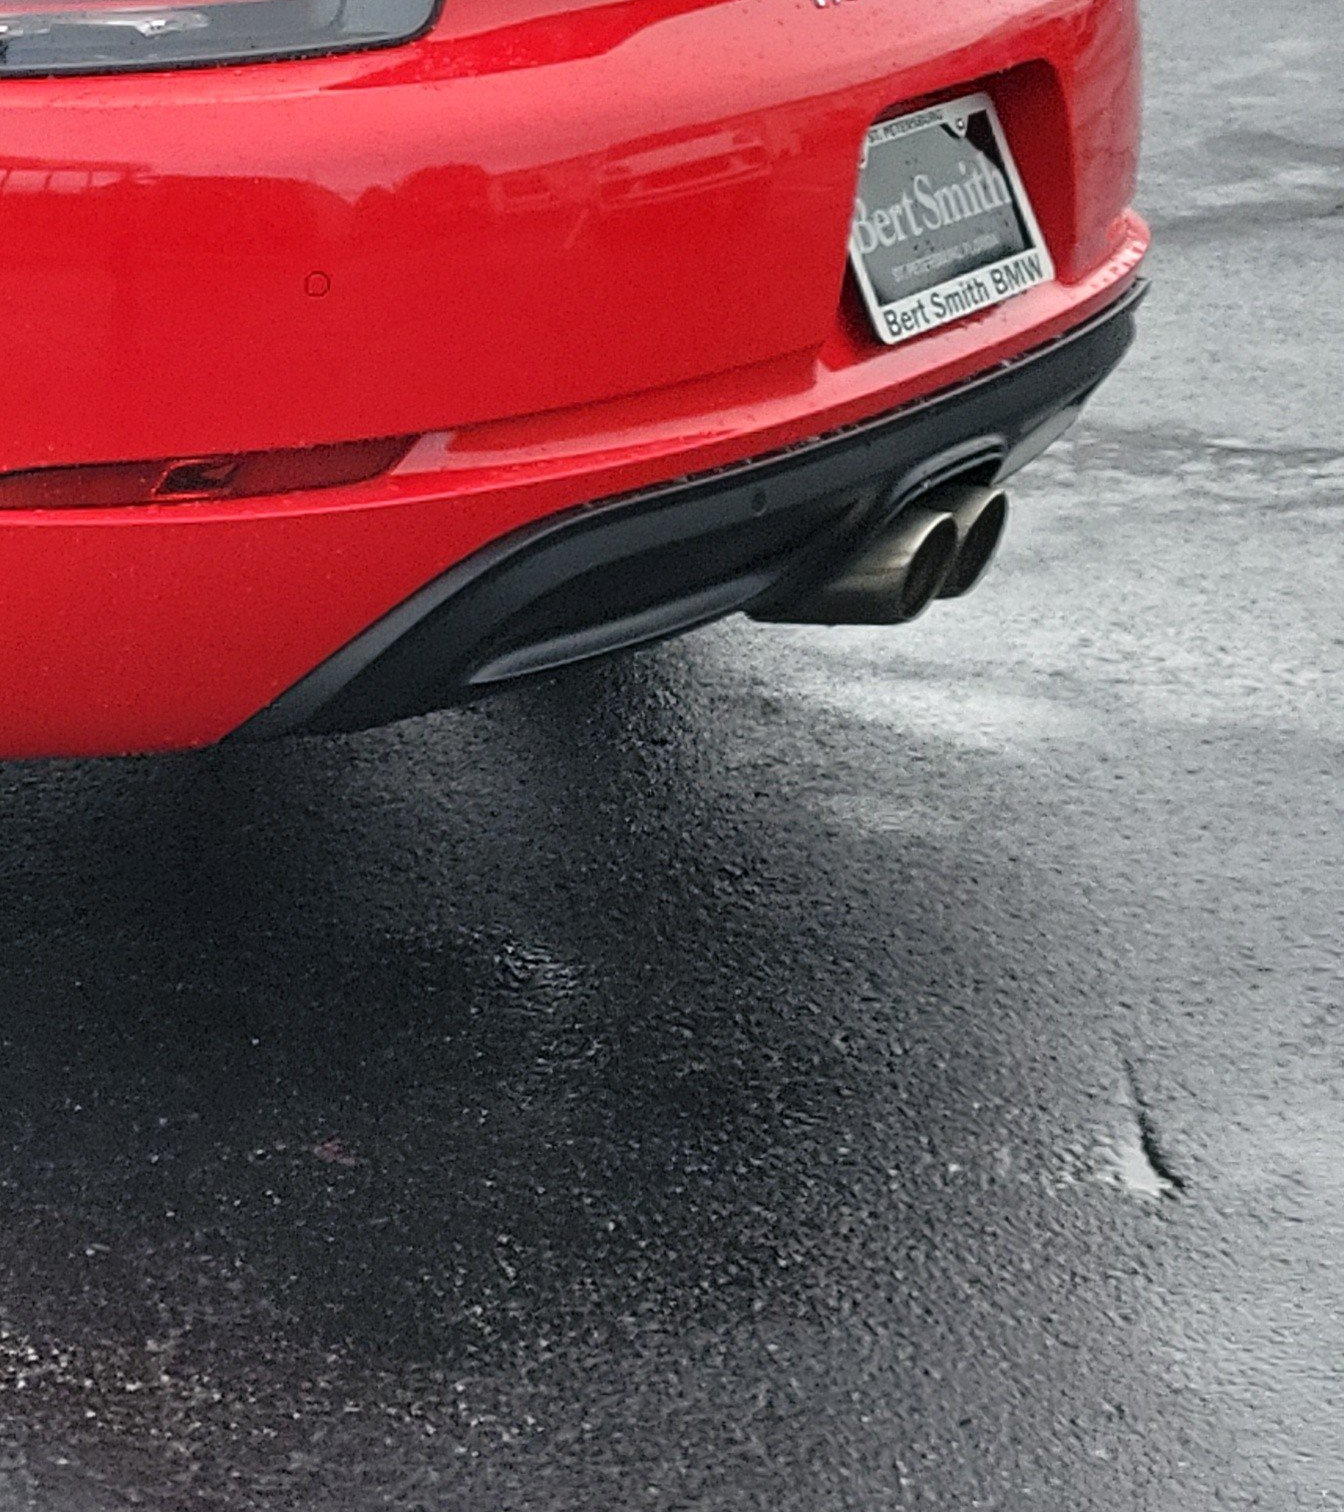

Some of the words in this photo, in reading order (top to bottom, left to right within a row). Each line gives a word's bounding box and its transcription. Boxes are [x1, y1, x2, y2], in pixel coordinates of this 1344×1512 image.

[853, 191, 924, 255] Bert
[913, 151, 1012, 230] Smith
[882, 299, 931, 337] Bert
[930, 278, 991, 319] Smith
[989, 254, 1044, 296] BMW
